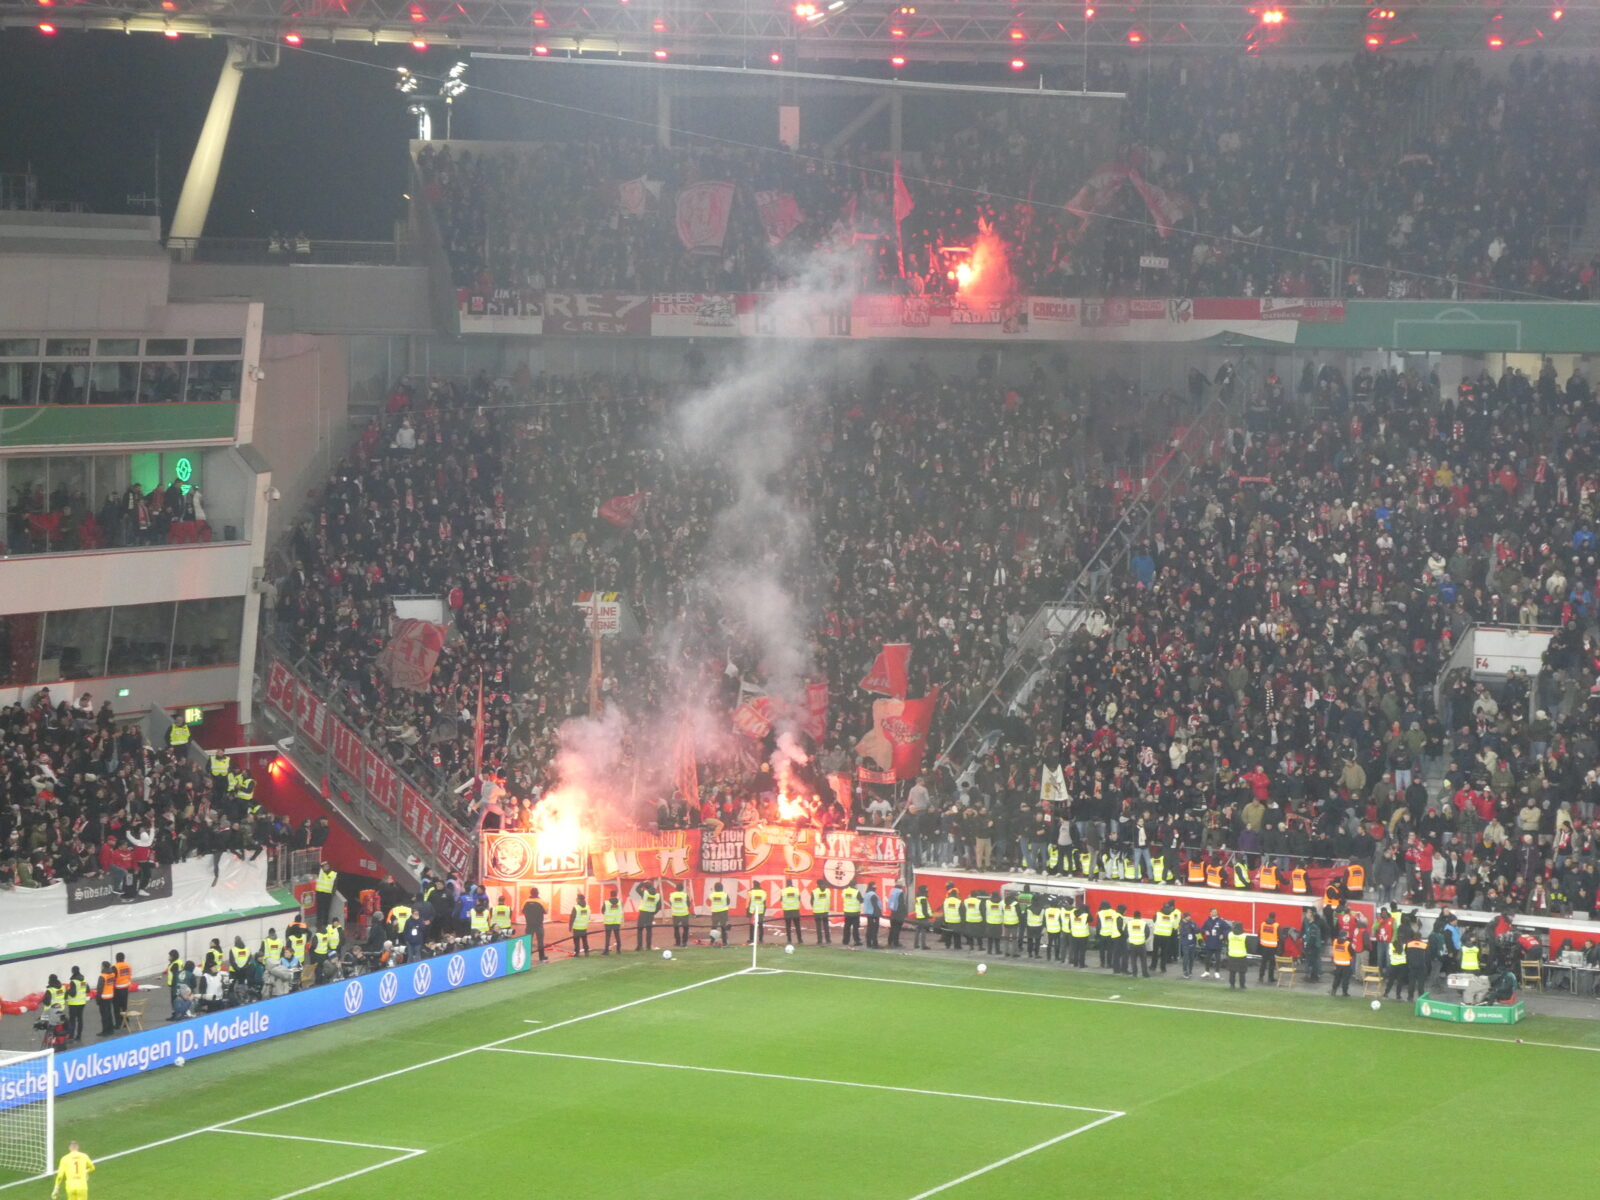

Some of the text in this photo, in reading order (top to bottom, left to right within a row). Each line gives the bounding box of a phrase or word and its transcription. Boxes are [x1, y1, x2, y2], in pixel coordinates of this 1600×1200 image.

[1475, 657, 1489, 669] F4
[702, 842, 744, 859] STADT
[702, 859, 744, 872] VERBOT
[63, 1040, 171, 1084] Volkswagen
[176, 1029, 199, 1053] ID.
[203, 1015, 270, 1047] Modelle
